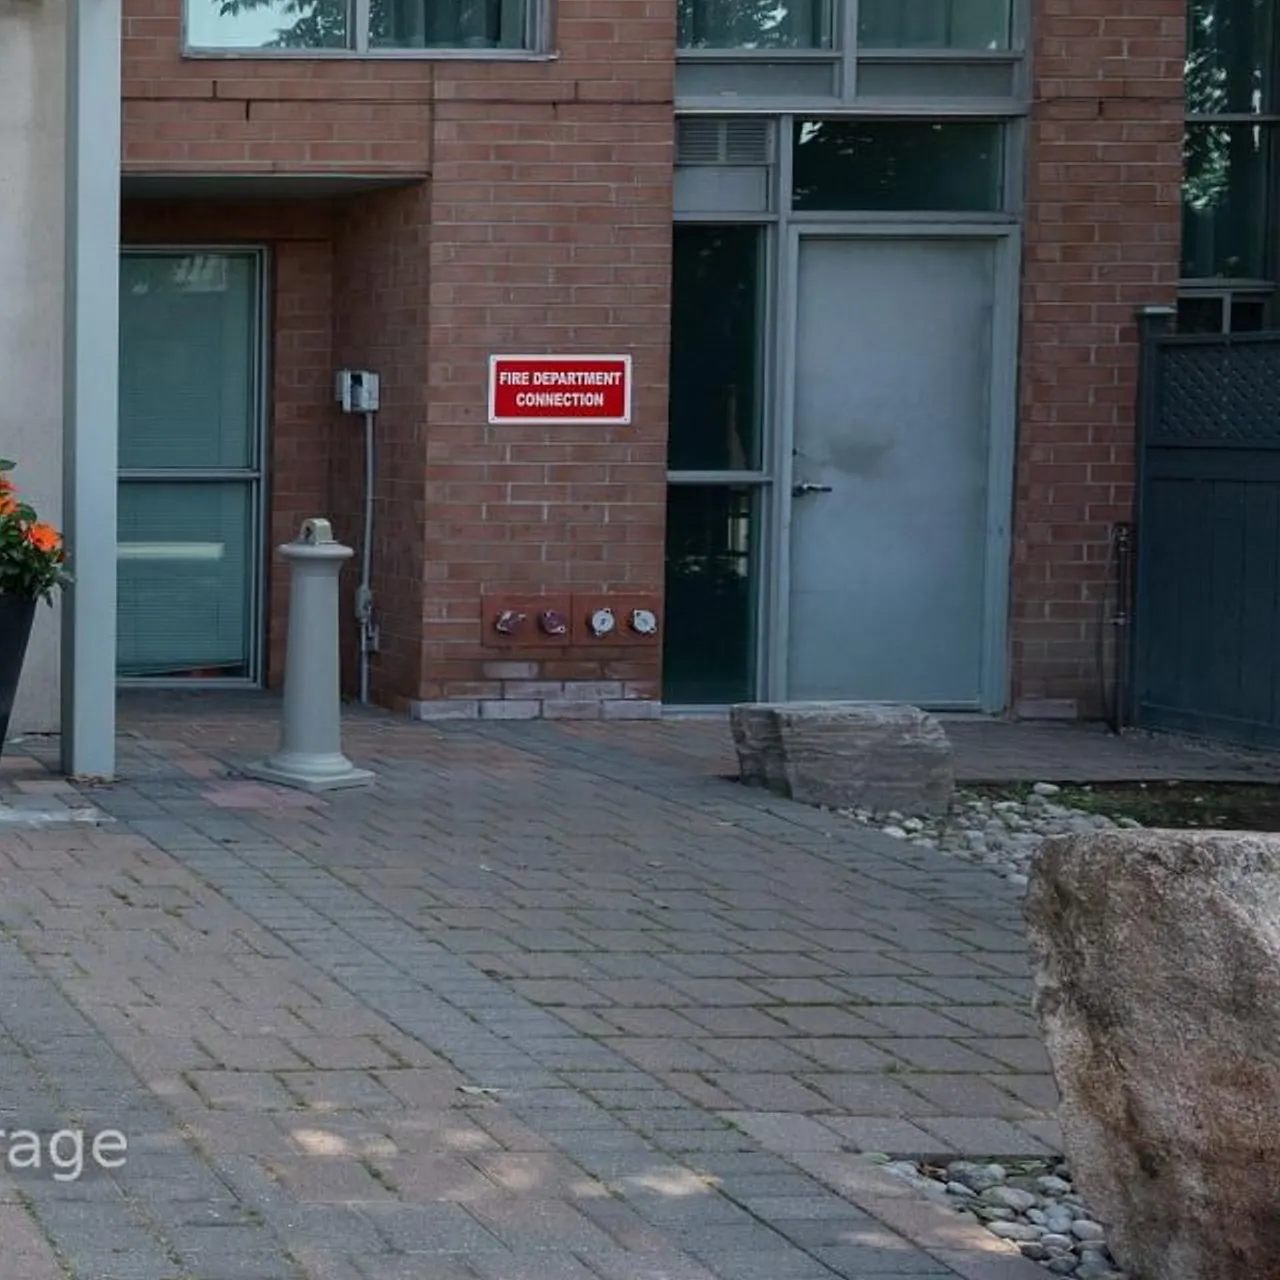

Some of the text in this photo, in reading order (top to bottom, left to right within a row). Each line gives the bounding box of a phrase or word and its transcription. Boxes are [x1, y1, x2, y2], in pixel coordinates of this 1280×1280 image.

[499, 372, 623, 385] FIRE DEPARTMENT
[515, 393, 604, 407] CONNECTION
